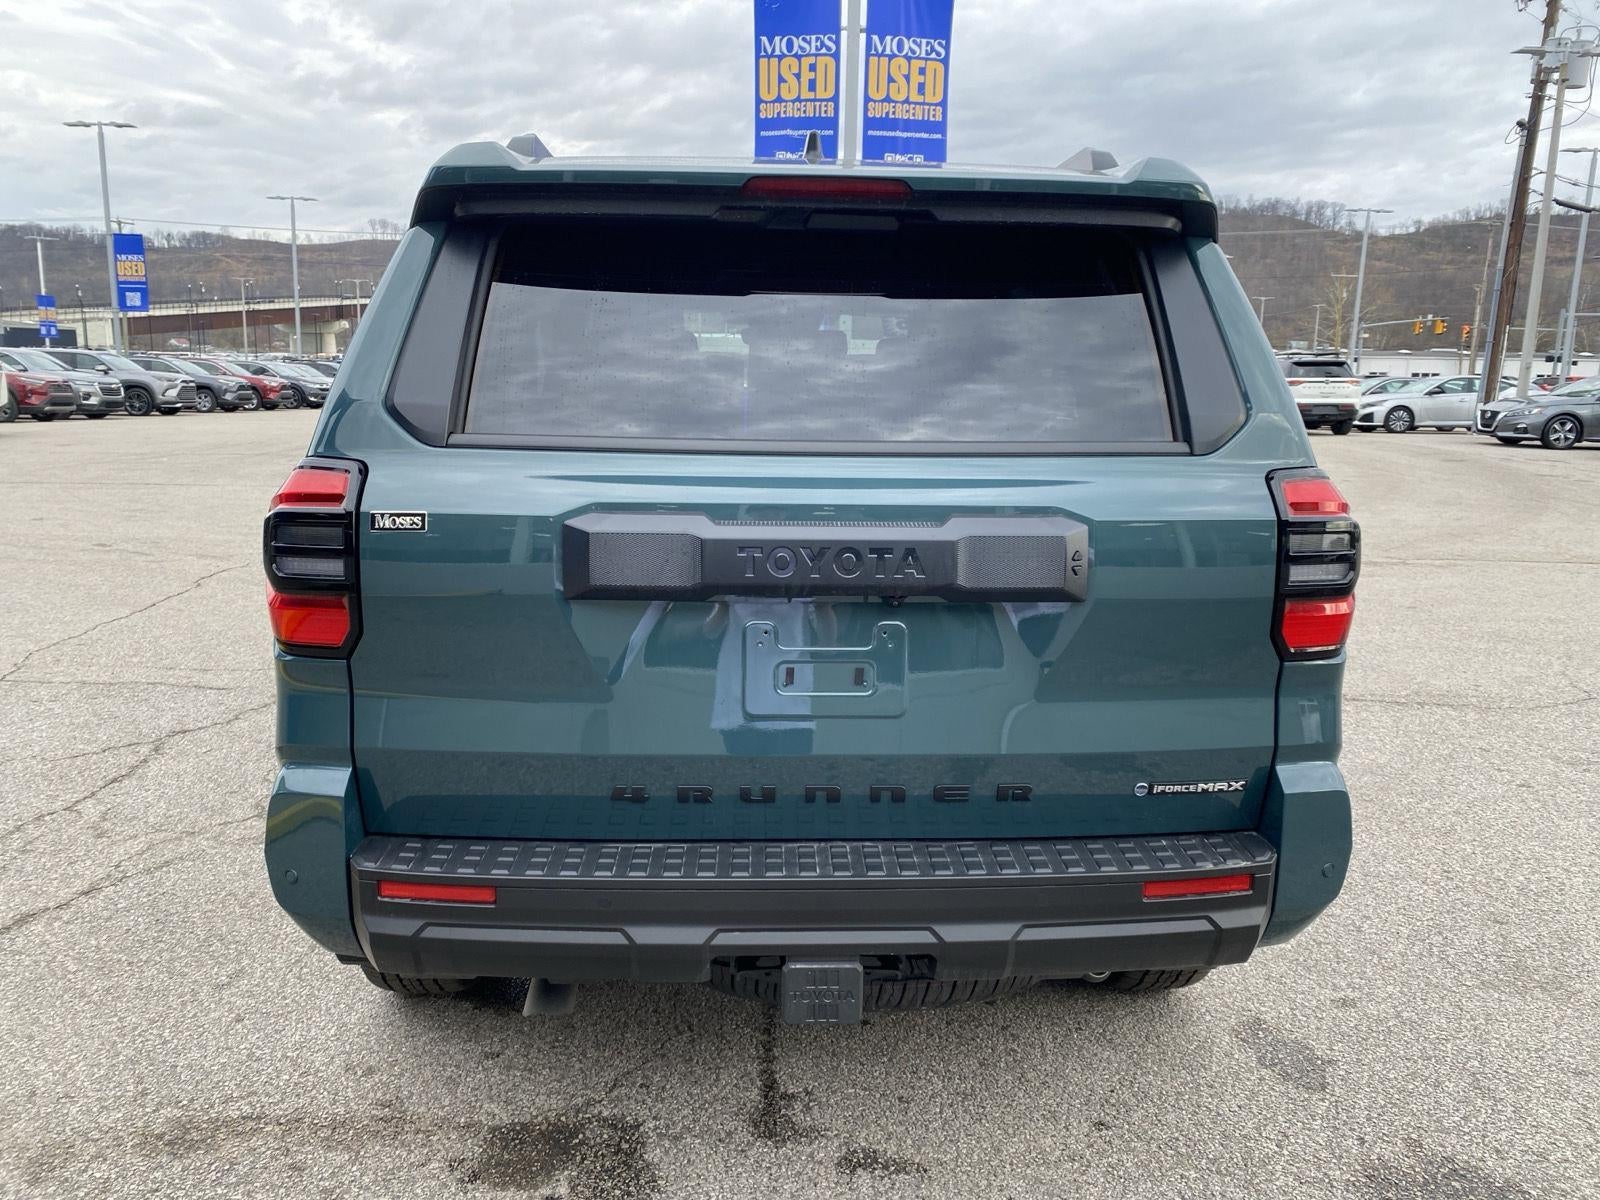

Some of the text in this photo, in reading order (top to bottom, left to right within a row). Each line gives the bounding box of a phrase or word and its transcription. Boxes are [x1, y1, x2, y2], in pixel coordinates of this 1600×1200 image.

[760, 34, 836, 55] MOSES
[870, 34, 946, 59] MOSES
[759, 56, 836, 101] USED
[868, 56, 945, 103] USED
[759, 102, 835, 119] SUPERCENTER
[867, 102, 943, 121] SUPERCENTER
[116, 254, 144, 262] MOSES
[117, 261, 145, 275] USED
[737, 546, 926, 578] TOYOTA
[611, 784, 1034, 804] 4RUNNER
[789, 990, 855, 1003] TOYOTA
